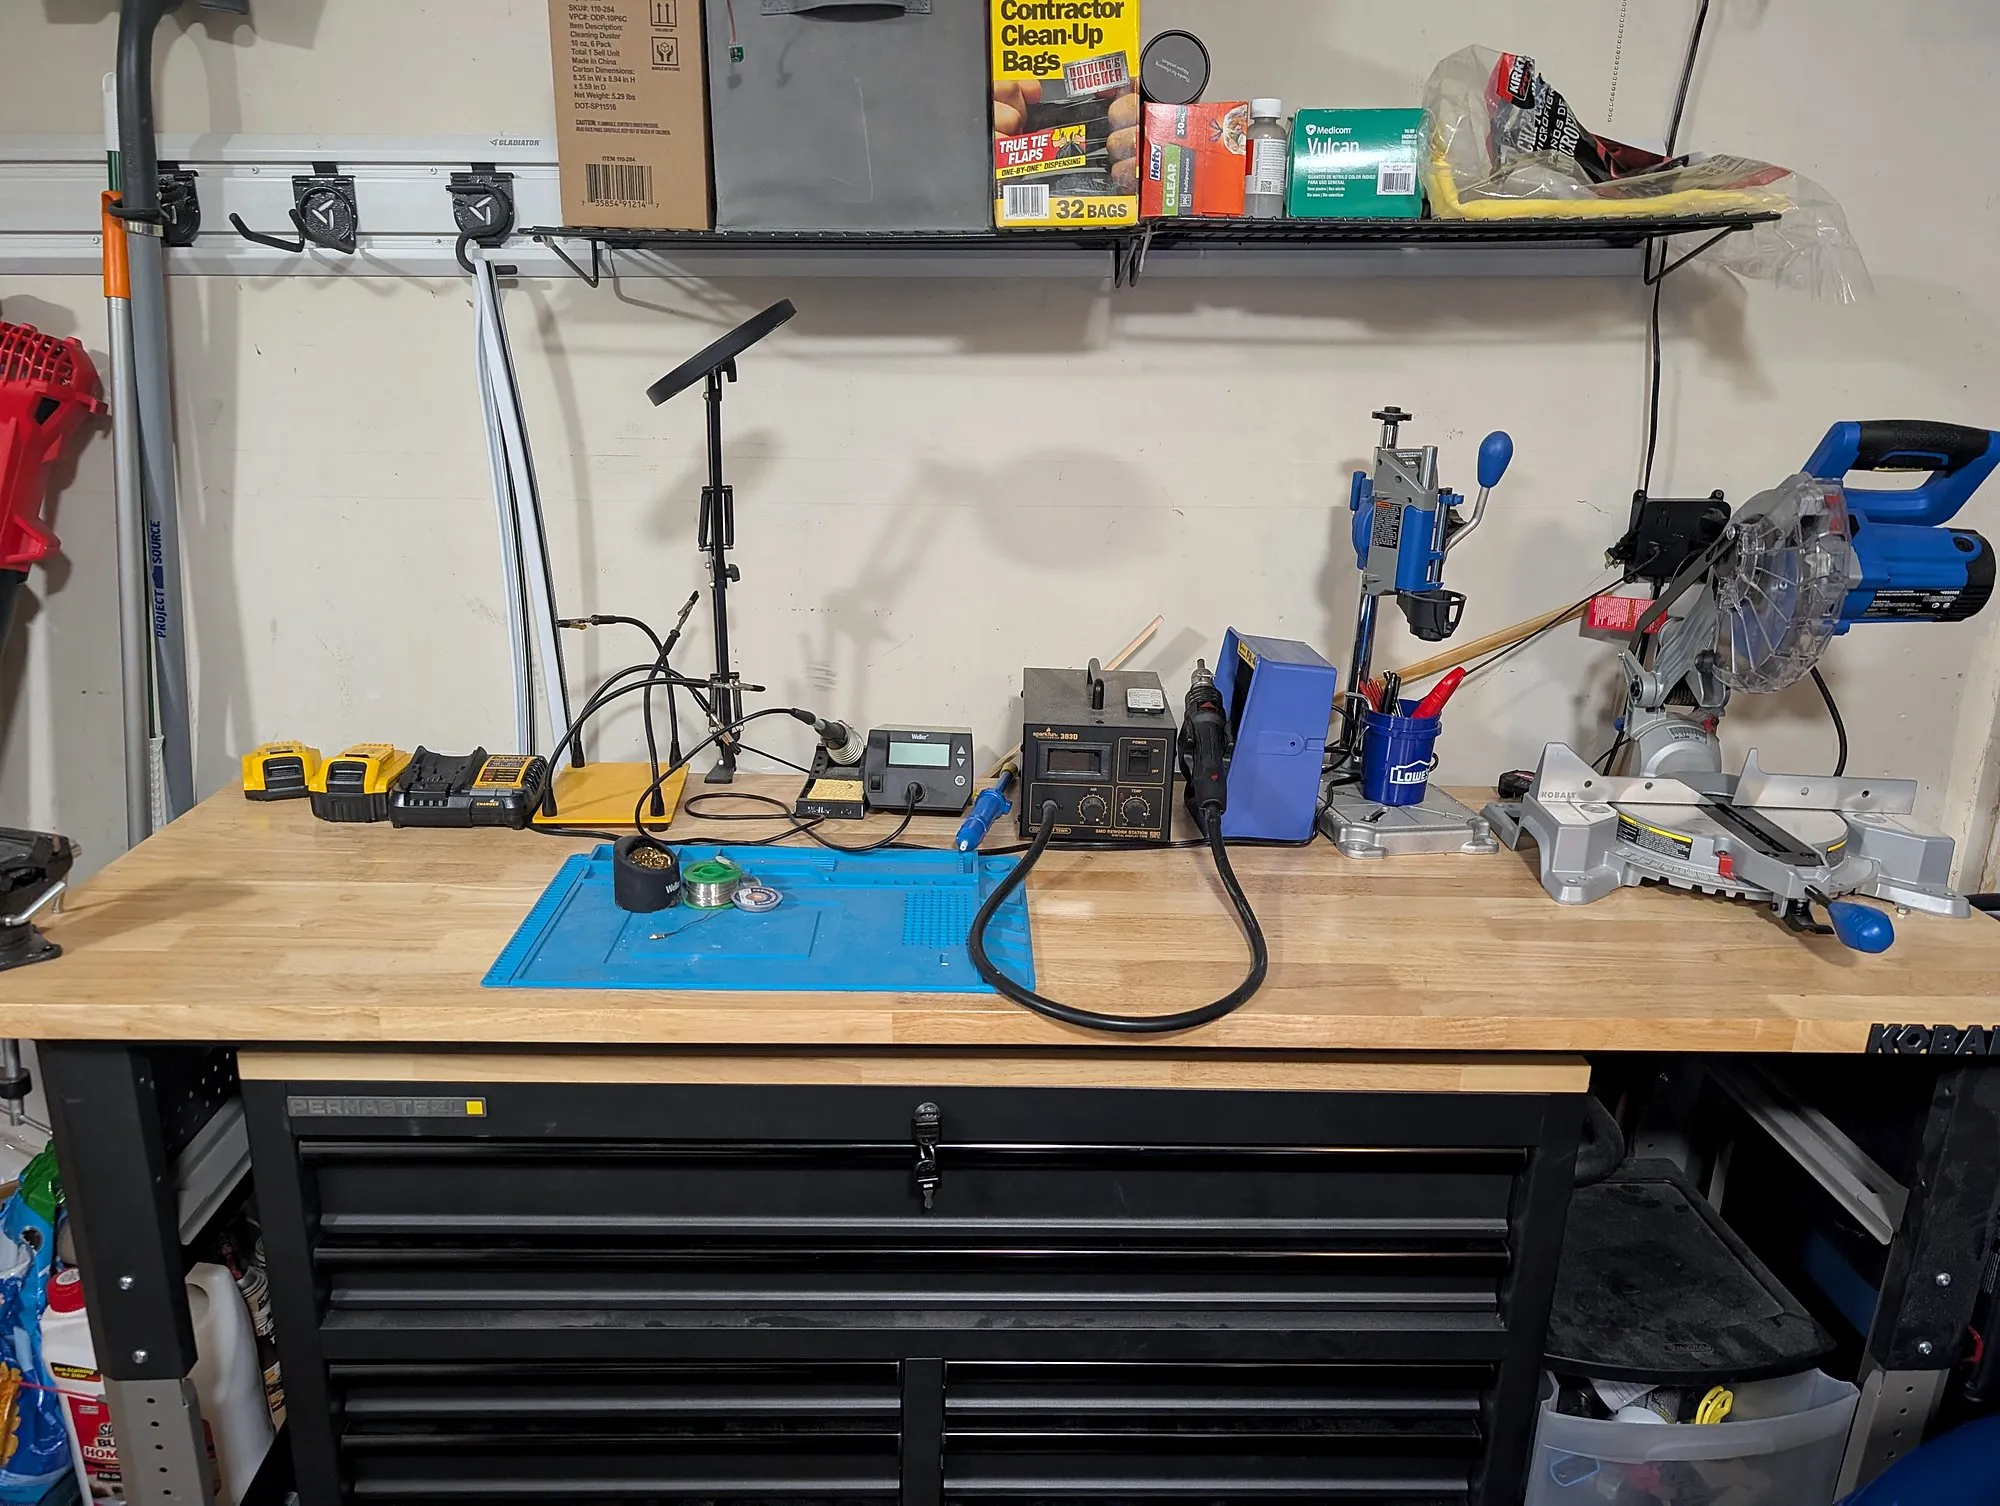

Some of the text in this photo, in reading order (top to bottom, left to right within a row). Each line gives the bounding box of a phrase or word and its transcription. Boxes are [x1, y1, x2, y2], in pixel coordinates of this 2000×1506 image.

[1001, 0, 1124, 20] Contractor
[571, 31, 598, 40] Cleaning
[1001, 23, 1103, 49] Clean-Up
[1002, 50, 1061, 76] Bags
[1069, 57, 1121, 79] NOTHING'S
[1509, 56, 1526, 93] KIRK
[1000, 134, 1049, 154] TRUE TIE
[1307, 137, 1360, 156] Vulcan
[1008, 148, 1043, 165] FLAPS
[1044, 157, 1081, 170] DISPENSING
[1151, 145, 1162, 179] Hefty
[1166, 164, 1177, 206] CLEAR
[1056, 199, 1127, 218] 32 BAGS
[150, 520, 167, 638] PROJECT SOURCE
[1397, 769, 1428, 782] LOWE
[1865, 1023, 2000, 1055] KOBA
[290, 1100, 466, 1115] PERMASTEEL
[85, 1447, 118, 1459] HOM
